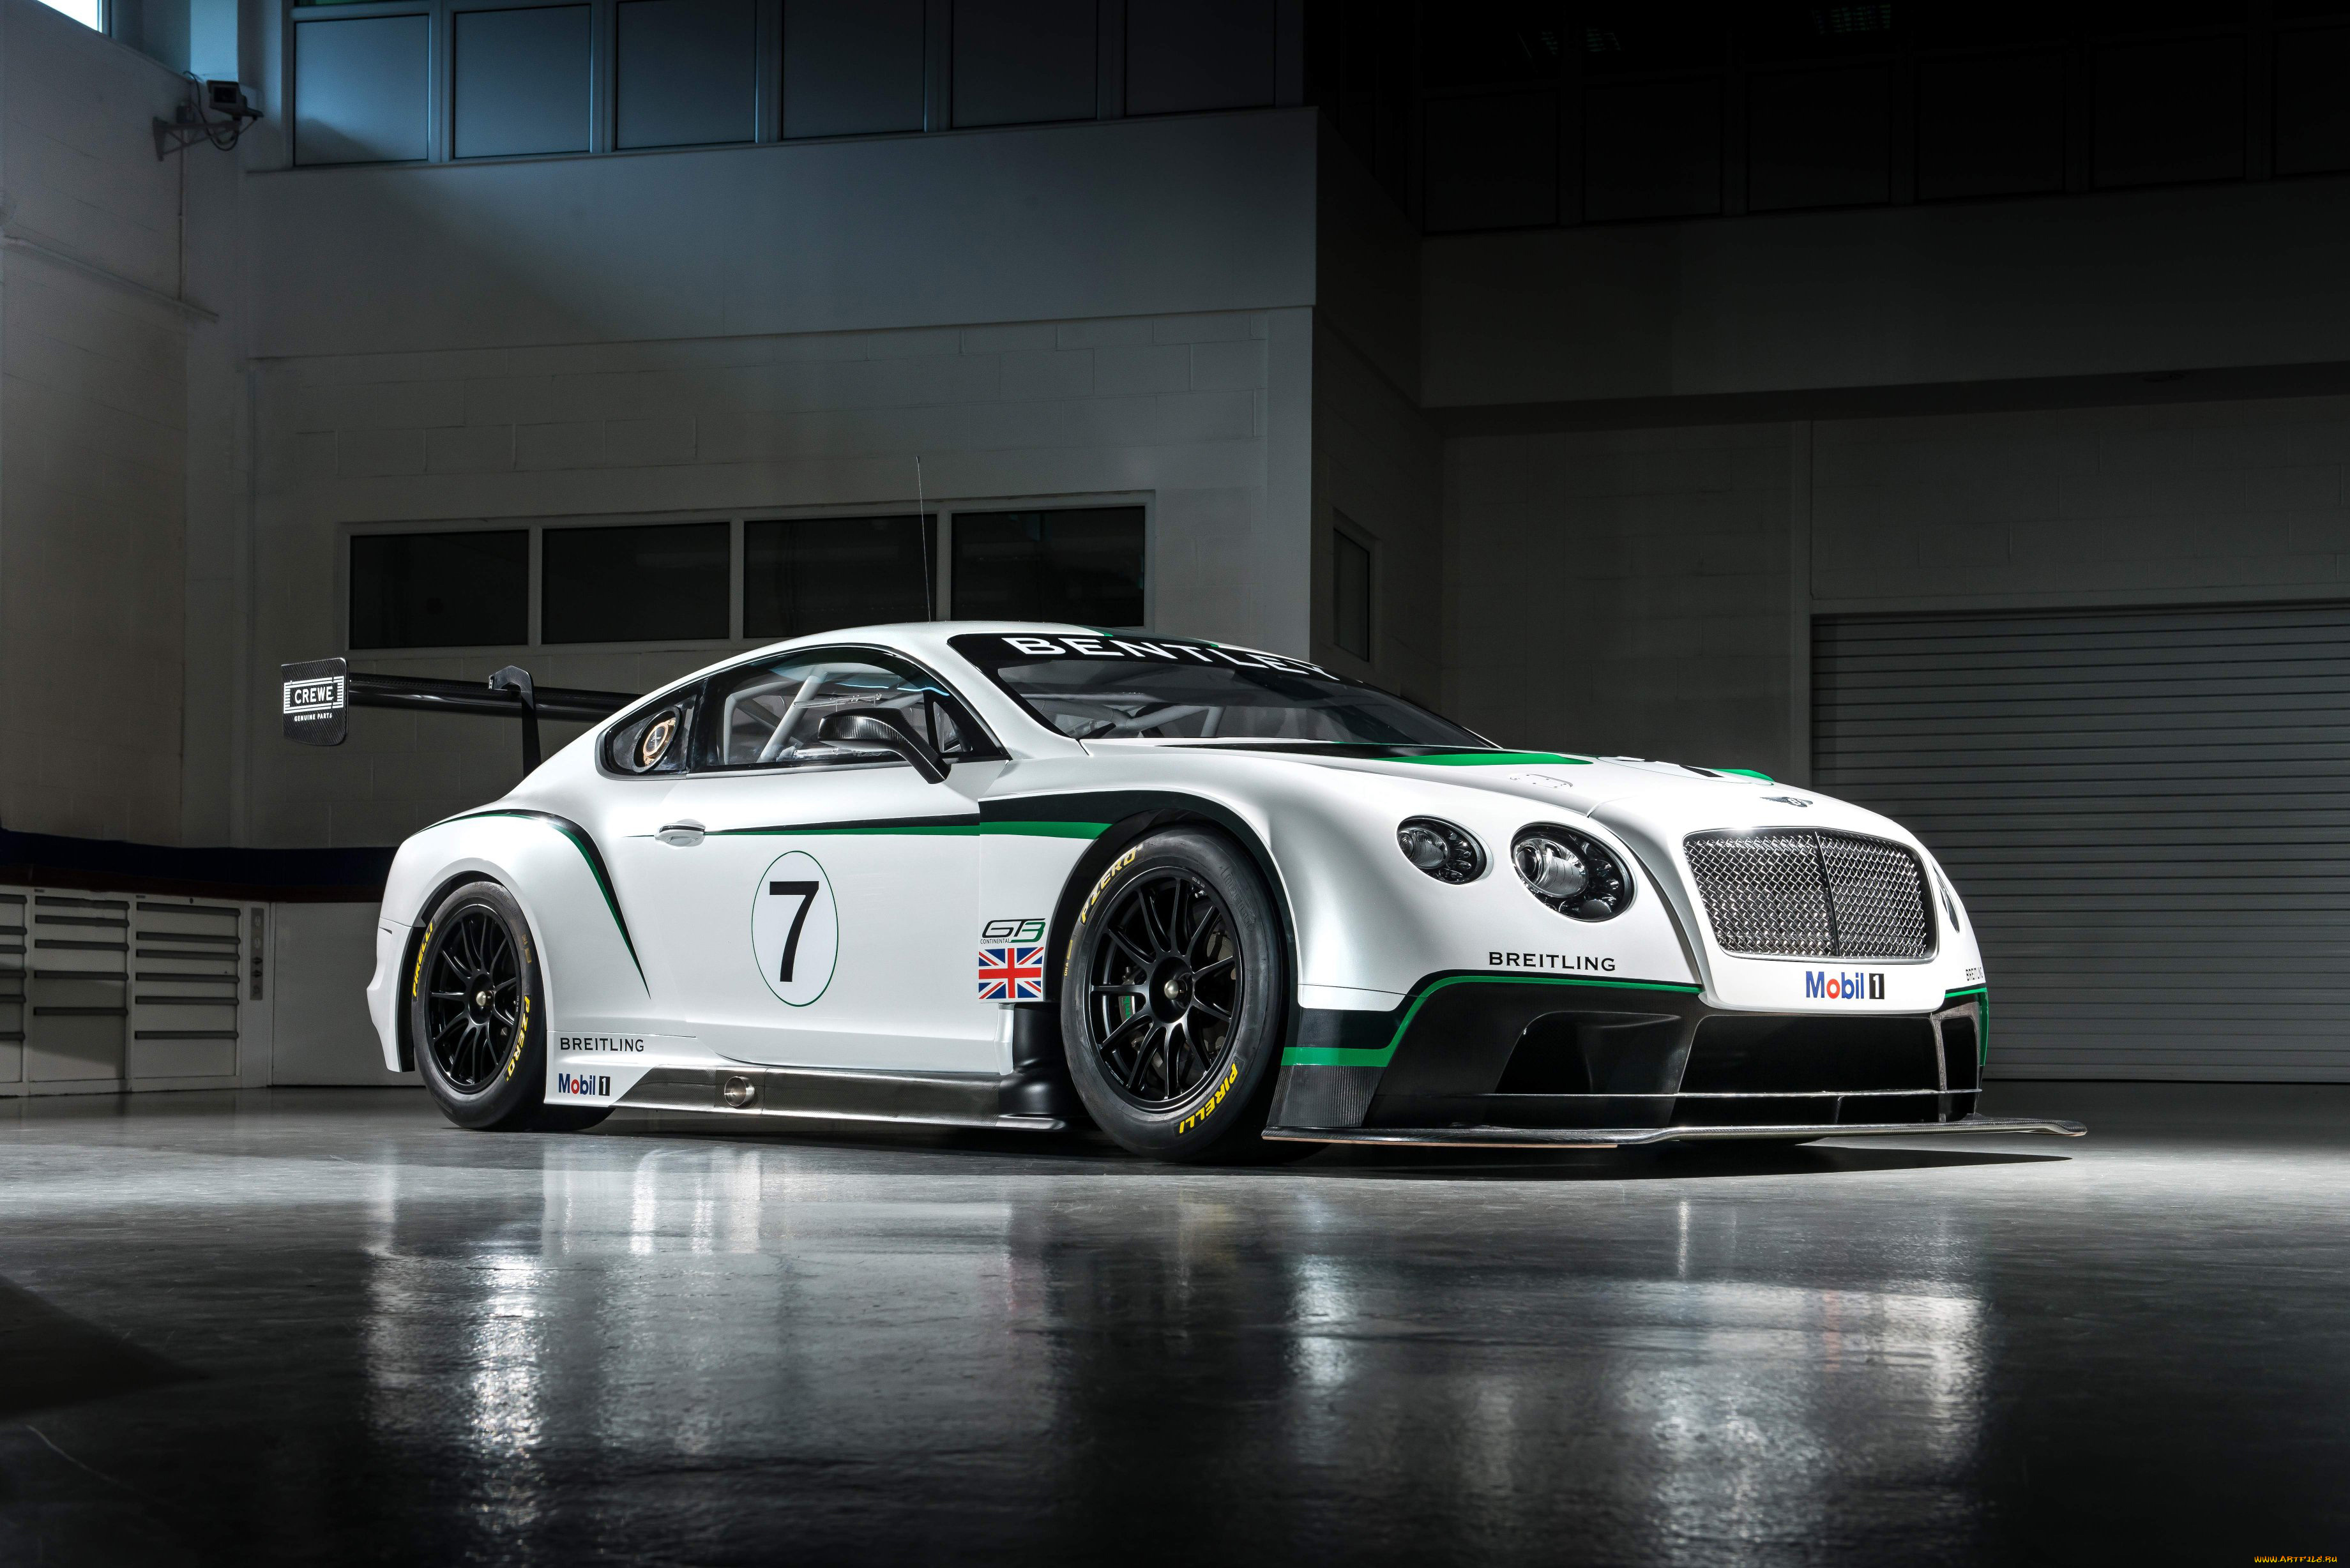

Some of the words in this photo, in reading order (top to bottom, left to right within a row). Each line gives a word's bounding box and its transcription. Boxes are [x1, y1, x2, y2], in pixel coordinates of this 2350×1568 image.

[1001, 637, 1340, 681] BENTLEY
[294, 686, 334, 704] CREWE
[294, 714, 316, 722] GENUINE
[317, 712, 333, 720] PARTS
[769, 880, 819, 983] 7
[982, 917, 1046, 943] GT3
[413, 922, 434, 998] PIRELLI
[1489, 951, 1616, 972] BREITLING
[1805, 971, 1865, 999] Mobil
[559, 1037, 645, 1052] BREITLING
[558, 1073, 596, 1096] Mobil
[1179, 1062, 1239, 1134] PIRELLI
